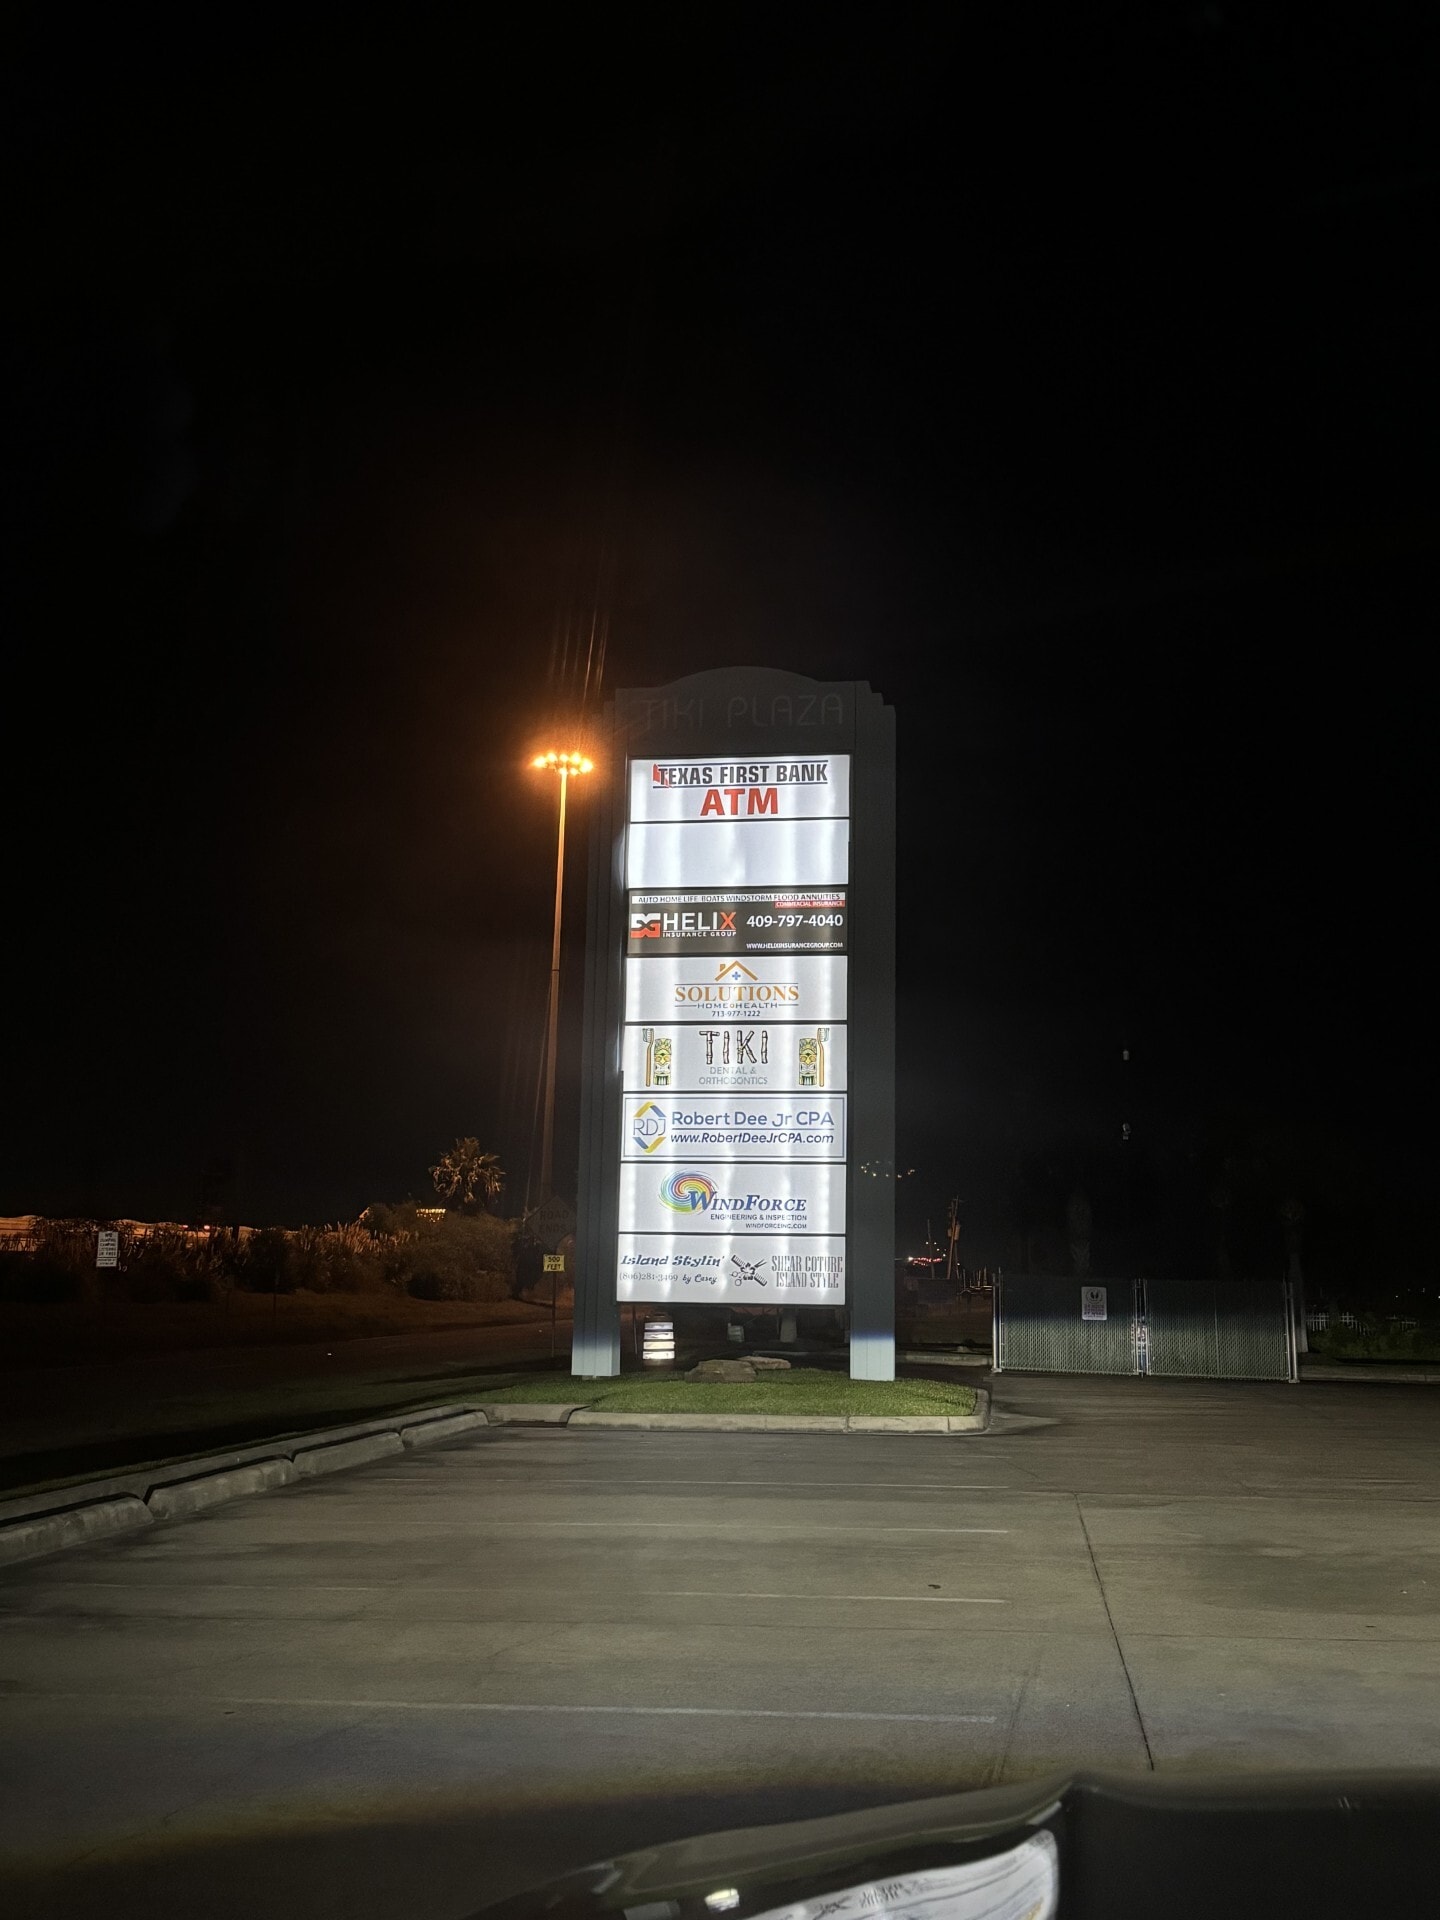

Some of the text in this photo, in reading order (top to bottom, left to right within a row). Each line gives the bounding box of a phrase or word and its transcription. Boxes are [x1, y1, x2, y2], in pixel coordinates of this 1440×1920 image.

[638, 693, 843, 729] TIKI PLAZA
[658, 763, 828, 785] TEXAS FIRST BANK
[700, 788, 779, 817] ATM
[660, 896, 682, 904] HOME
[726, 894, 772, 902] WINDSTORM
[773, 894, 799, 902] FLOOD
[663, 912, 737, 931] HELIX
[746, 915, 843, 928] 409-797-4040
[746, 942, 843, 950] WWW.HELIXINSURANCEGROUP.COM
[674, 985, 799, 1003] SOLUTIONS
[698, 1029, 769, 1065] TIKI
[709, 1066, 757, 1075] DENTAL &
[698, 1076, 768, 1085] ORTHODONTICS
[633, 1117, 666, 1137] RDJ
[671, 1111, 834, 1128] Robert Dee Jr CPA
[670, 1131, 834, 1145] www.RobertDeeJrCPA.com
[539, 1210, 570, 1235] ROAD ENDS
[711, 1213, 807, 1221] ENGINEERING & INSPECTION
[746, 1222, 807, 1230] WINDFORCEINC.COM
[546, 1263, 562, 1271] FEET
[621, 1254, 725, 1267] Island Stylin'
[771, 1256, 843, 1273] SHEAR COTURE
[682, 1274, 691, 1284] by
[695, 1274, 718, 1285] Casey
[776, 1272, 839, 1289] ISLAND STYLE
